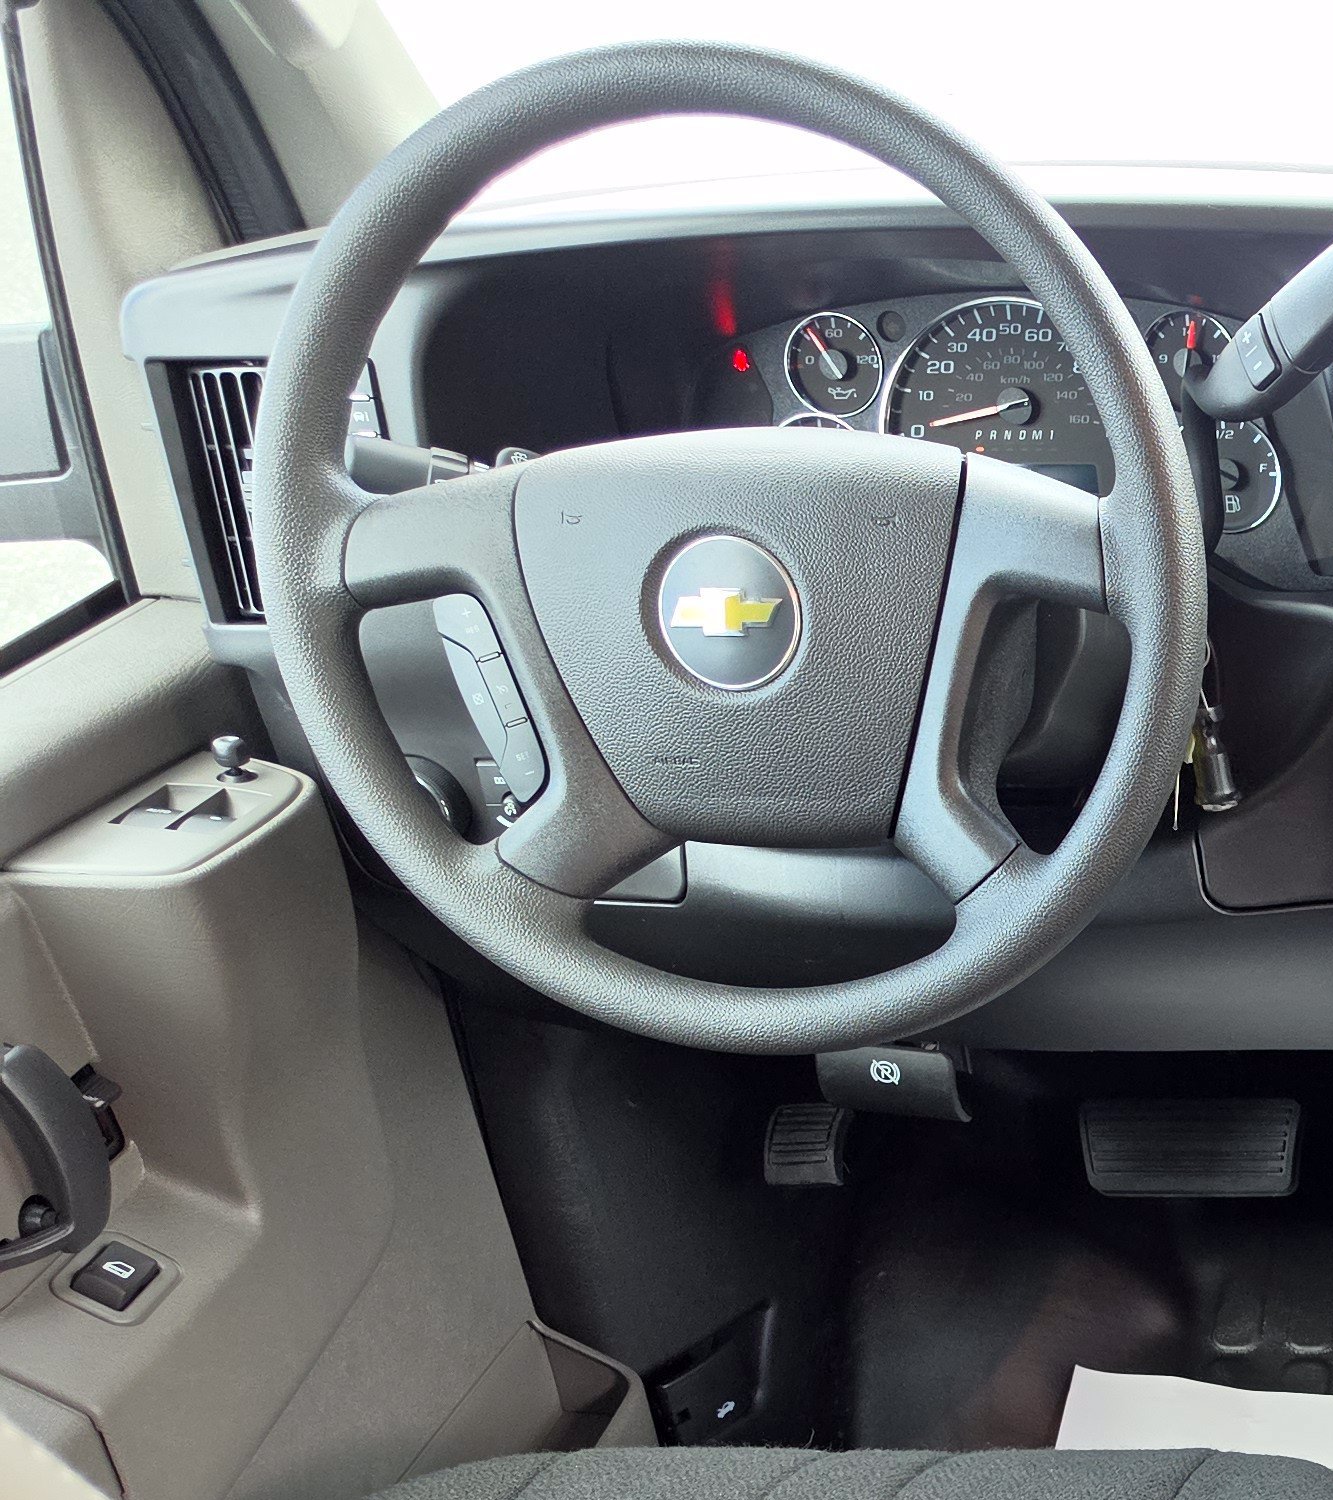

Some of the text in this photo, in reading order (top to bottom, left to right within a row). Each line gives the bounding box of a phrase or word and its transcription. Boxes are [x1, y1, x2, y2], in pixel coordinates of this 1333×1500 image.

[825, 329, 843, 338] 60
[1000, 324, 1021, 334] 50
[967, 328, 997, 342] 40
[1025, 328, 1052, 342] 60
[947, 342, 968, 353] 30
[805, 356, 815, 365] 0
[856, 355, 877, 364] 120
[1004, 355, 1020, 364] 80
[1159, 354, 1168, 363] 9
[927, 361, 954, 374] 20
[983, 361, 1000, 370] 60
[1023, 361, 1044, 370] 100
[966, 373, 984, 382] 40
[1000, 375, 1030, 384] km/h
[1043, 373, 1063, 382] 120
[919, 390, 934, 401] 10
[955, 393, 973, 402] 20
[1056, 391, 1078, 400] 140
[1069, 415, 1090, 424] 160
[910, 425, 925, 438] 0
[1260, 464, 1268, 473] F
